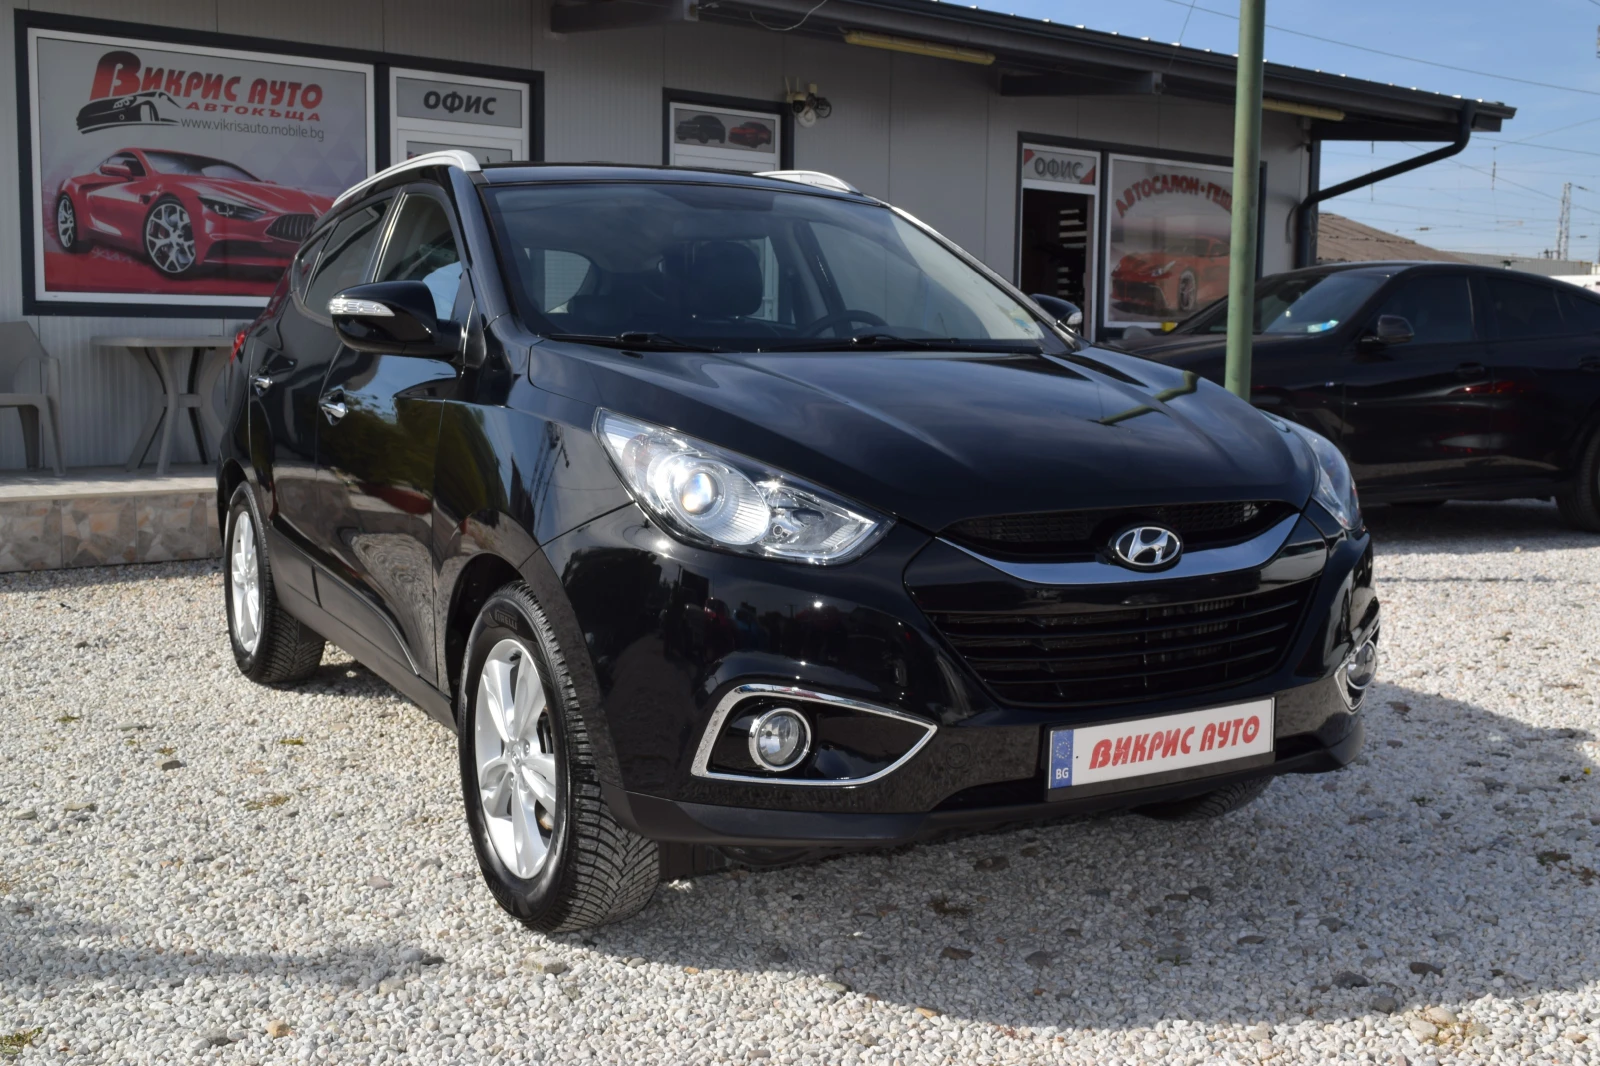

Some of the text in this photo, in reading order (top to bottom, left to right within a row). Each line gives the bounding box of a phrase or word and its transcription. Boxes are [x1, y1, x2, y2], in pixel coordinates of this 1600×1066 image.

[247, 77, 323, 110] АУТО
[423, 90, 497, 115] ОФИС
[185, 101, 321, 122] АВТОКЪЩА
[180, 117, 325, 142] www.vikrisauto.mobile.bg
[1034, 156, 1084, 180] ОФИС
[1199, 715, 1260, 752] АУТО
[1055, 767, 1069, 780] BG
